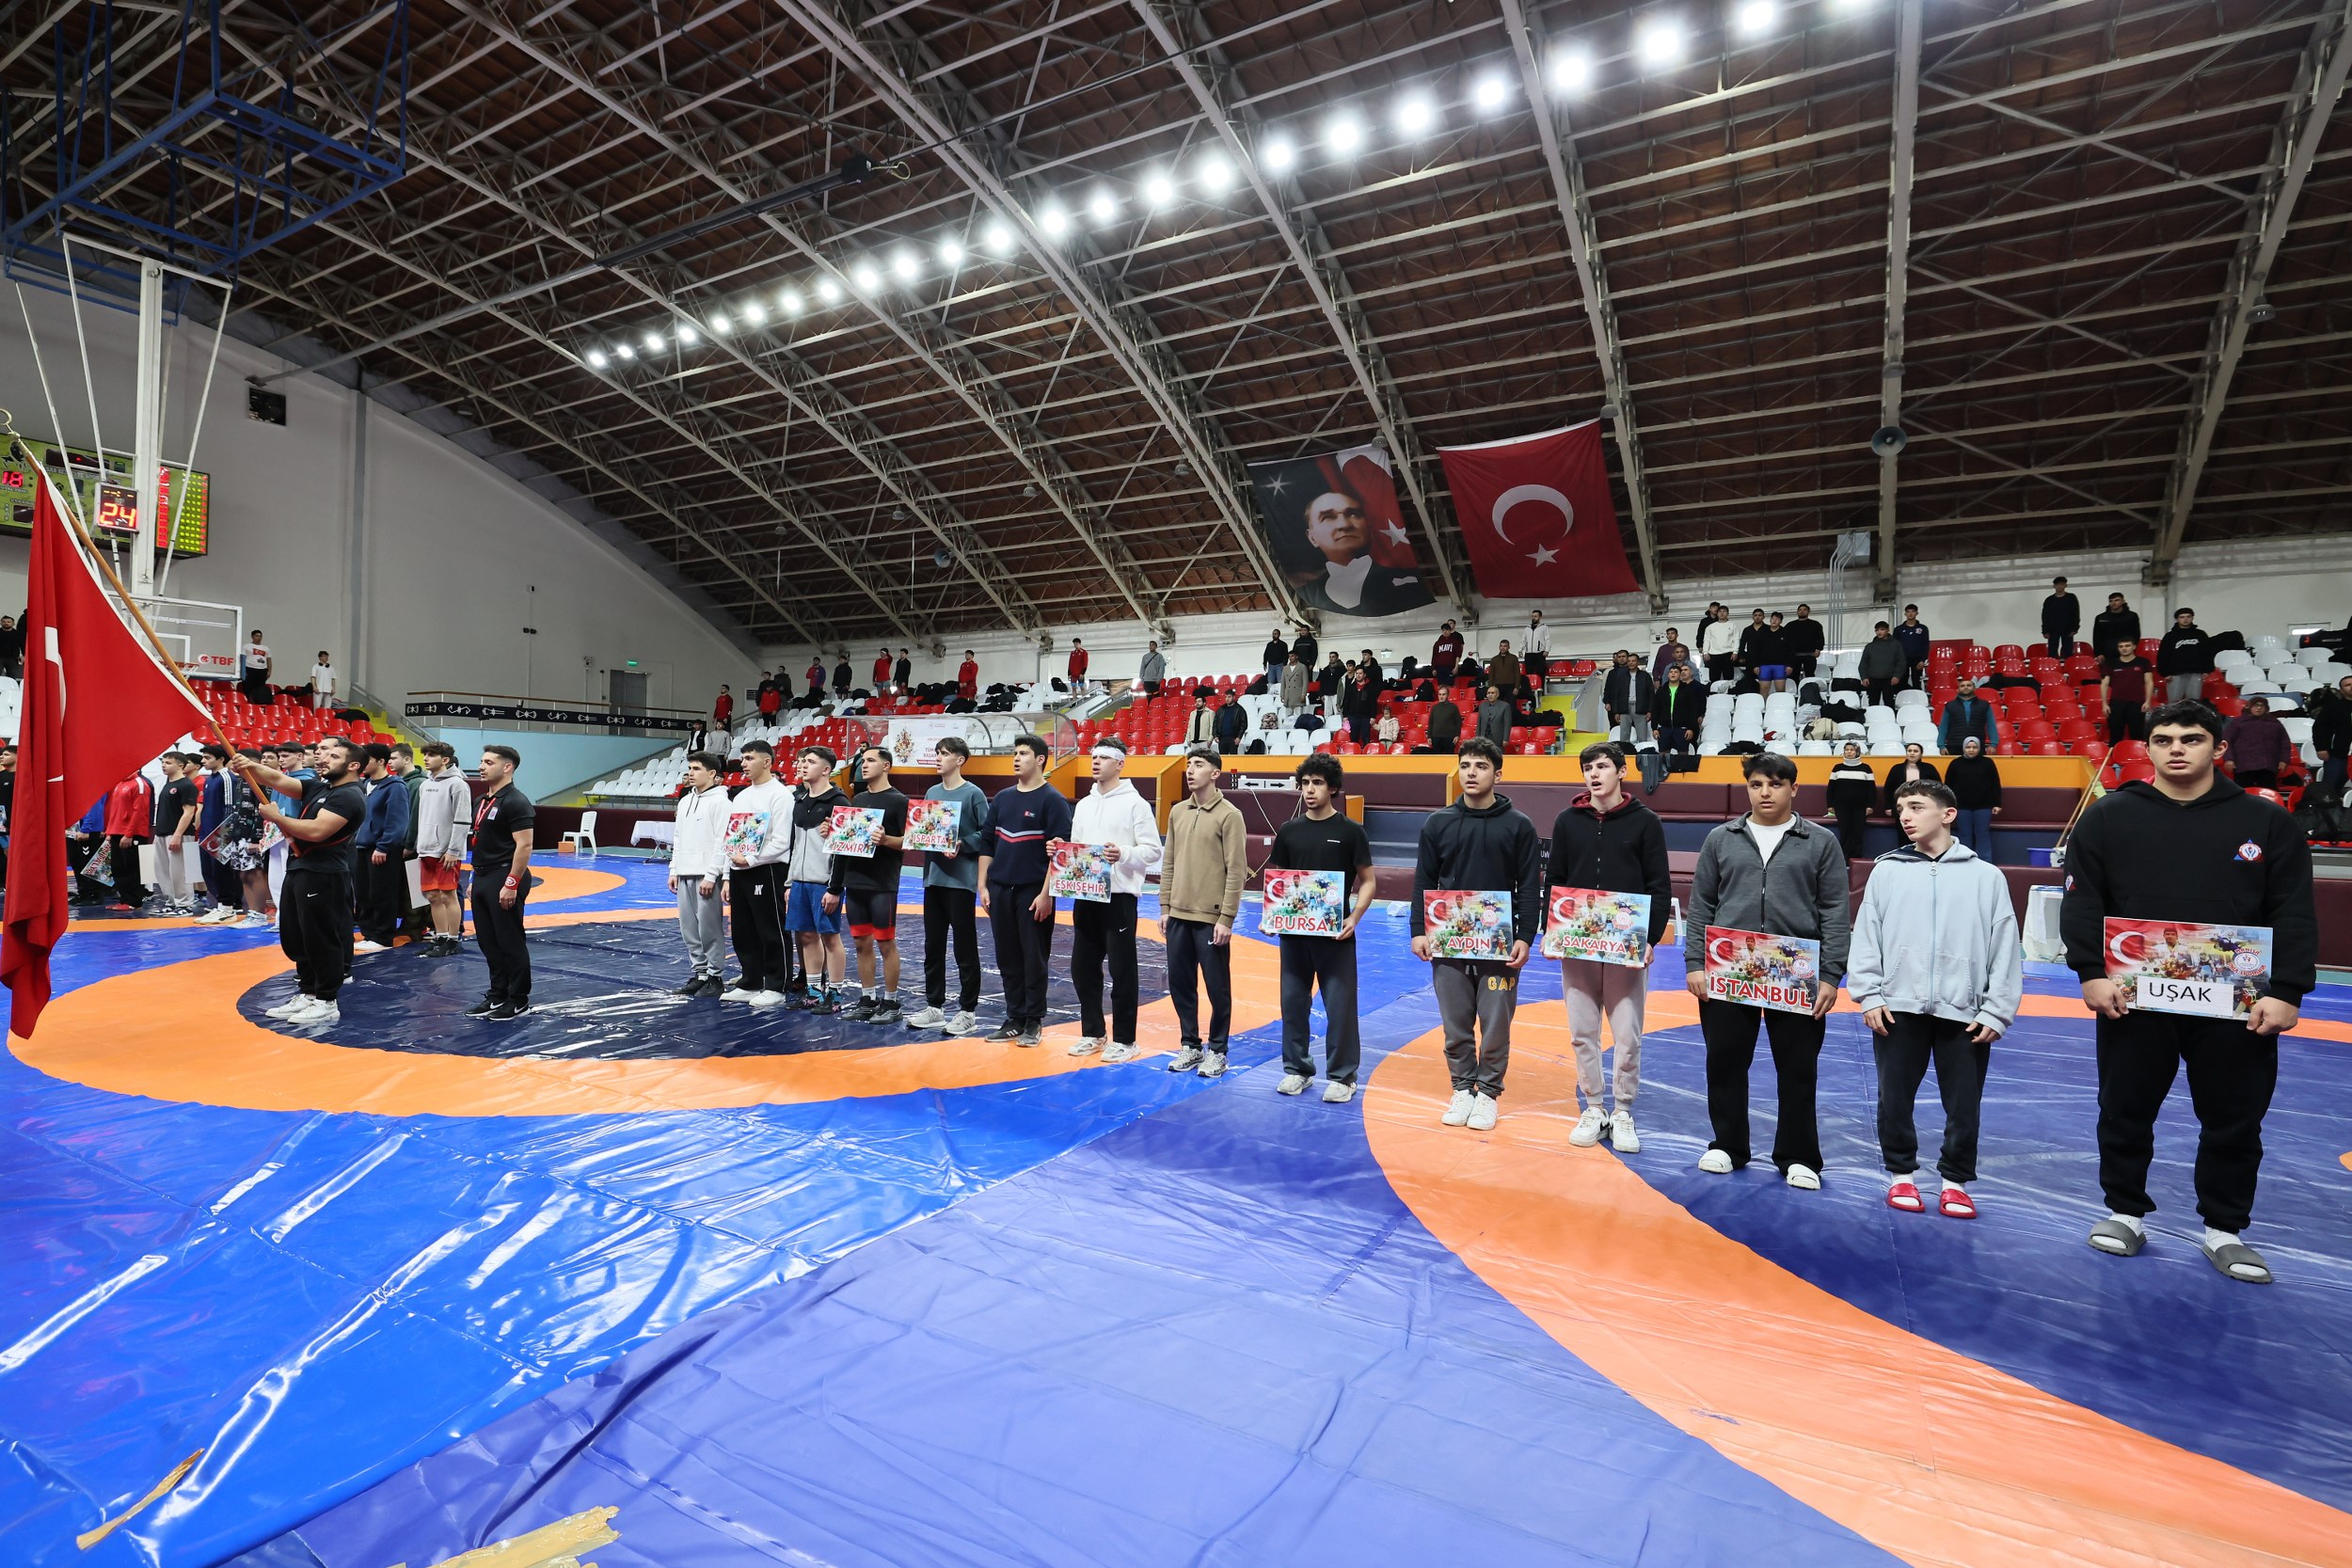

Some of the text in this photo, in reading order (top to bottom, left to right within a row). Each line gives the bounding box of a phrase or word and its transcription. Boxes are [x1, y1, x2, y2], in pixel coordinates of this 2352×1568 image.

[100, 502, 136, 527] 24
[211, 656, 234, 666] TBF
[833, 840, 866, 853] İZMİR
[914, 833, 947, 845] ISPARTA
[1055, 879, 1104, 894] ESKİŞEHİR
[1274, 915, 1328, 932] BURSA
[1447, 937, 1491, 949] AYDIN
[1563, 935, 1627, 953] SAKARYA
[1487, 976, 1516, 991] GAP
[1709, 972, 1811, 1008] İSTANBUL
[2149, 982, 2212, 1003] UŞAK
